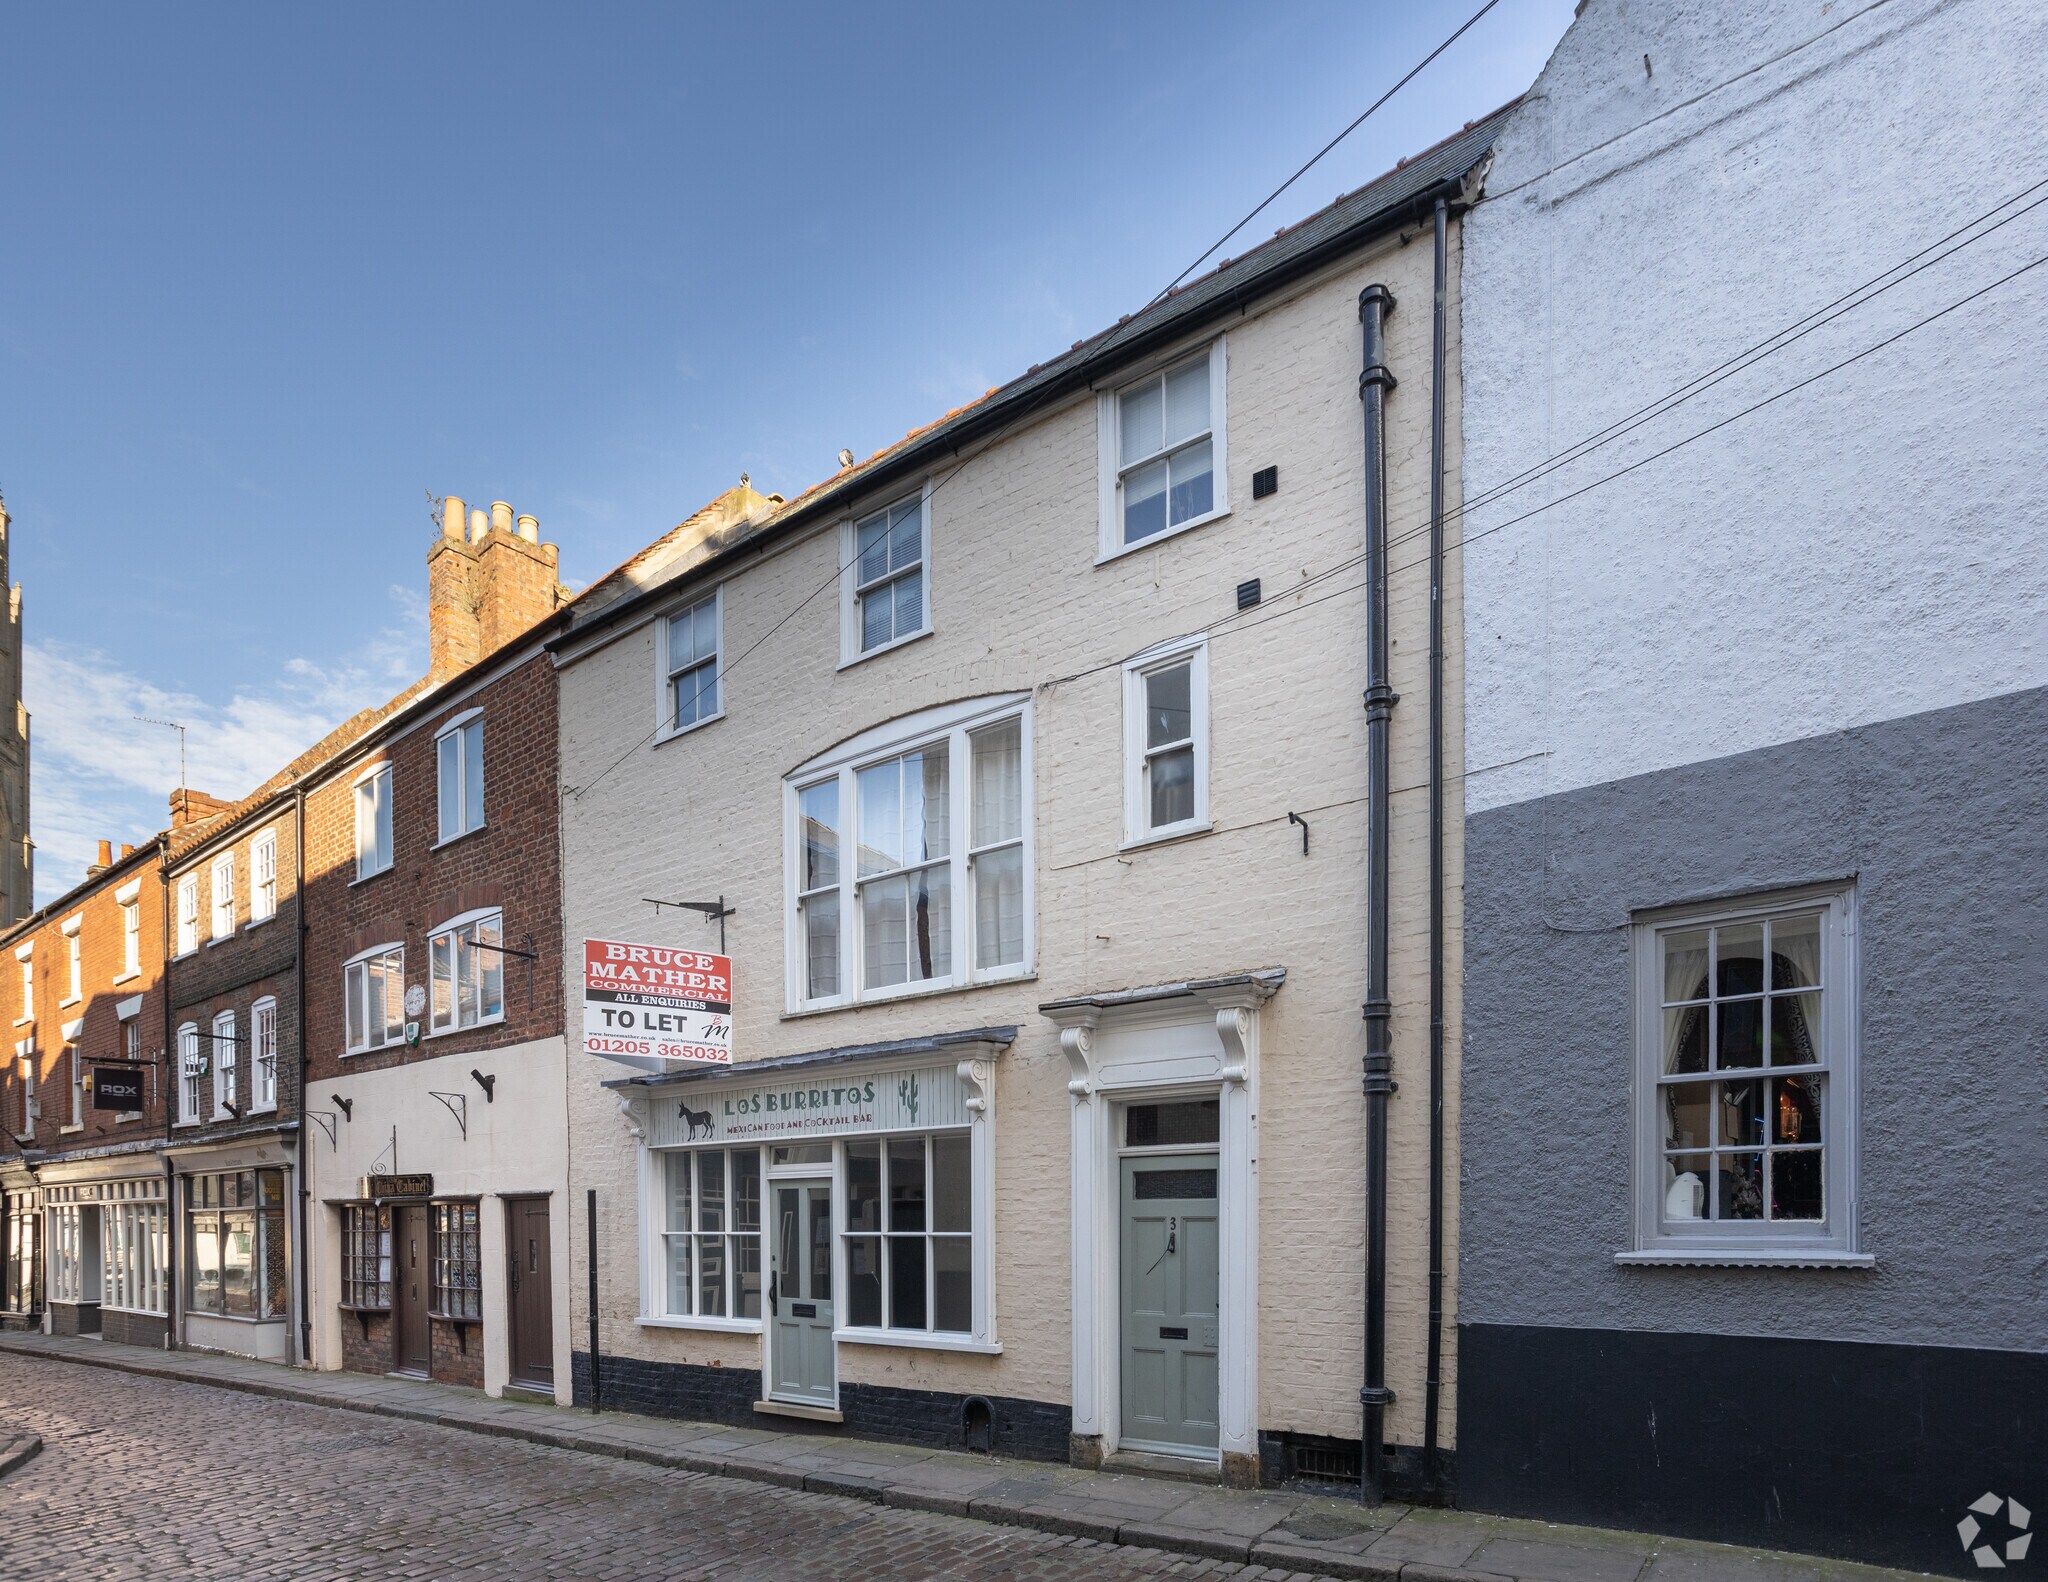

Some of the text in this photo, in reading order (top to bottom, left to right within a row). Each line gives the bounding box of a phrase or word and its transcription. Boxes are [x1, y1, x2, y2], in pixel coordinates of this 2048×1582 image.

[605, 943, 714, 971] BRUCE
[589, 961, 728, 992] MATHER
[589, 979, 728, 1002] COMMERCIAL
[614, 992, 707, 1010] ALL ENQUIRIES
[601, 1008, 688, 1033] TO LET
[587, 1037, 729, 1062] 01205 365032
[100, 1084, 137, 1095] ROX
[725, 1081, 875, 1116] LOS BURRITOS
[727, 1113, 873, 1134] MEXICAN FOOD AND COCKTAIL BAR
[1169, 1216, 1177, 1231] 3
